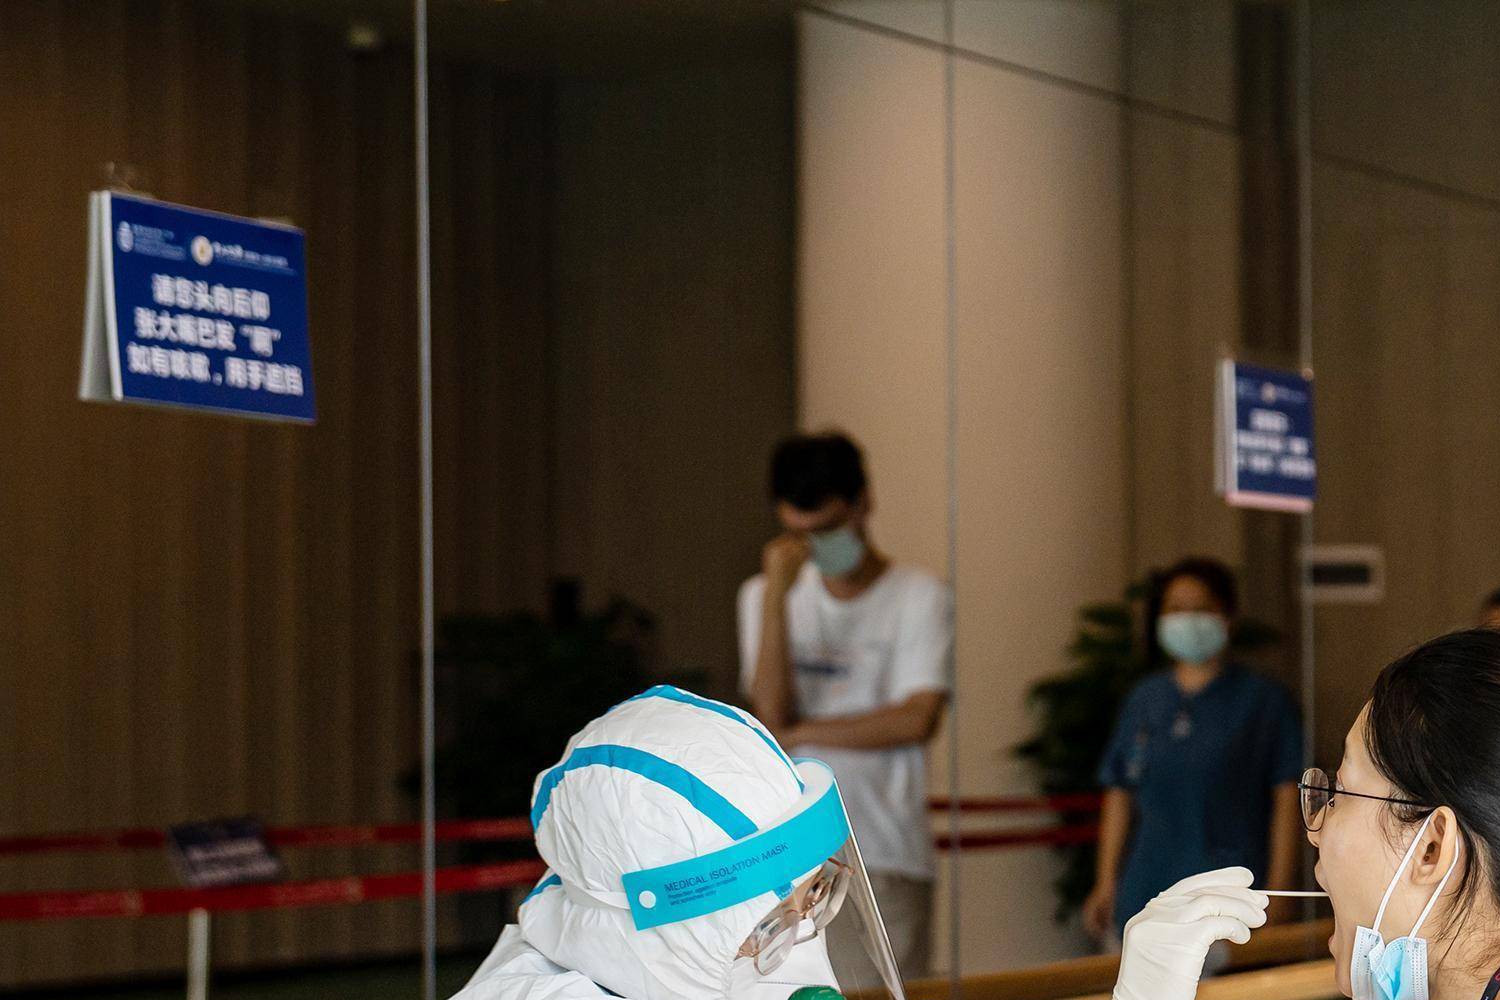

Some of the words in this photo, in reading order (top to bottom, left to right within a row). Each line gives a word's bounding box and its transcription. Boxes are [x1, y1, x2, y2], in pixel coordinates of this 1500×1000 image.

[664, 875, 706, 892] MEDICAL
[710, 855, 760, 880] ISOLATION
[762, 842, 789, 861] MASK
